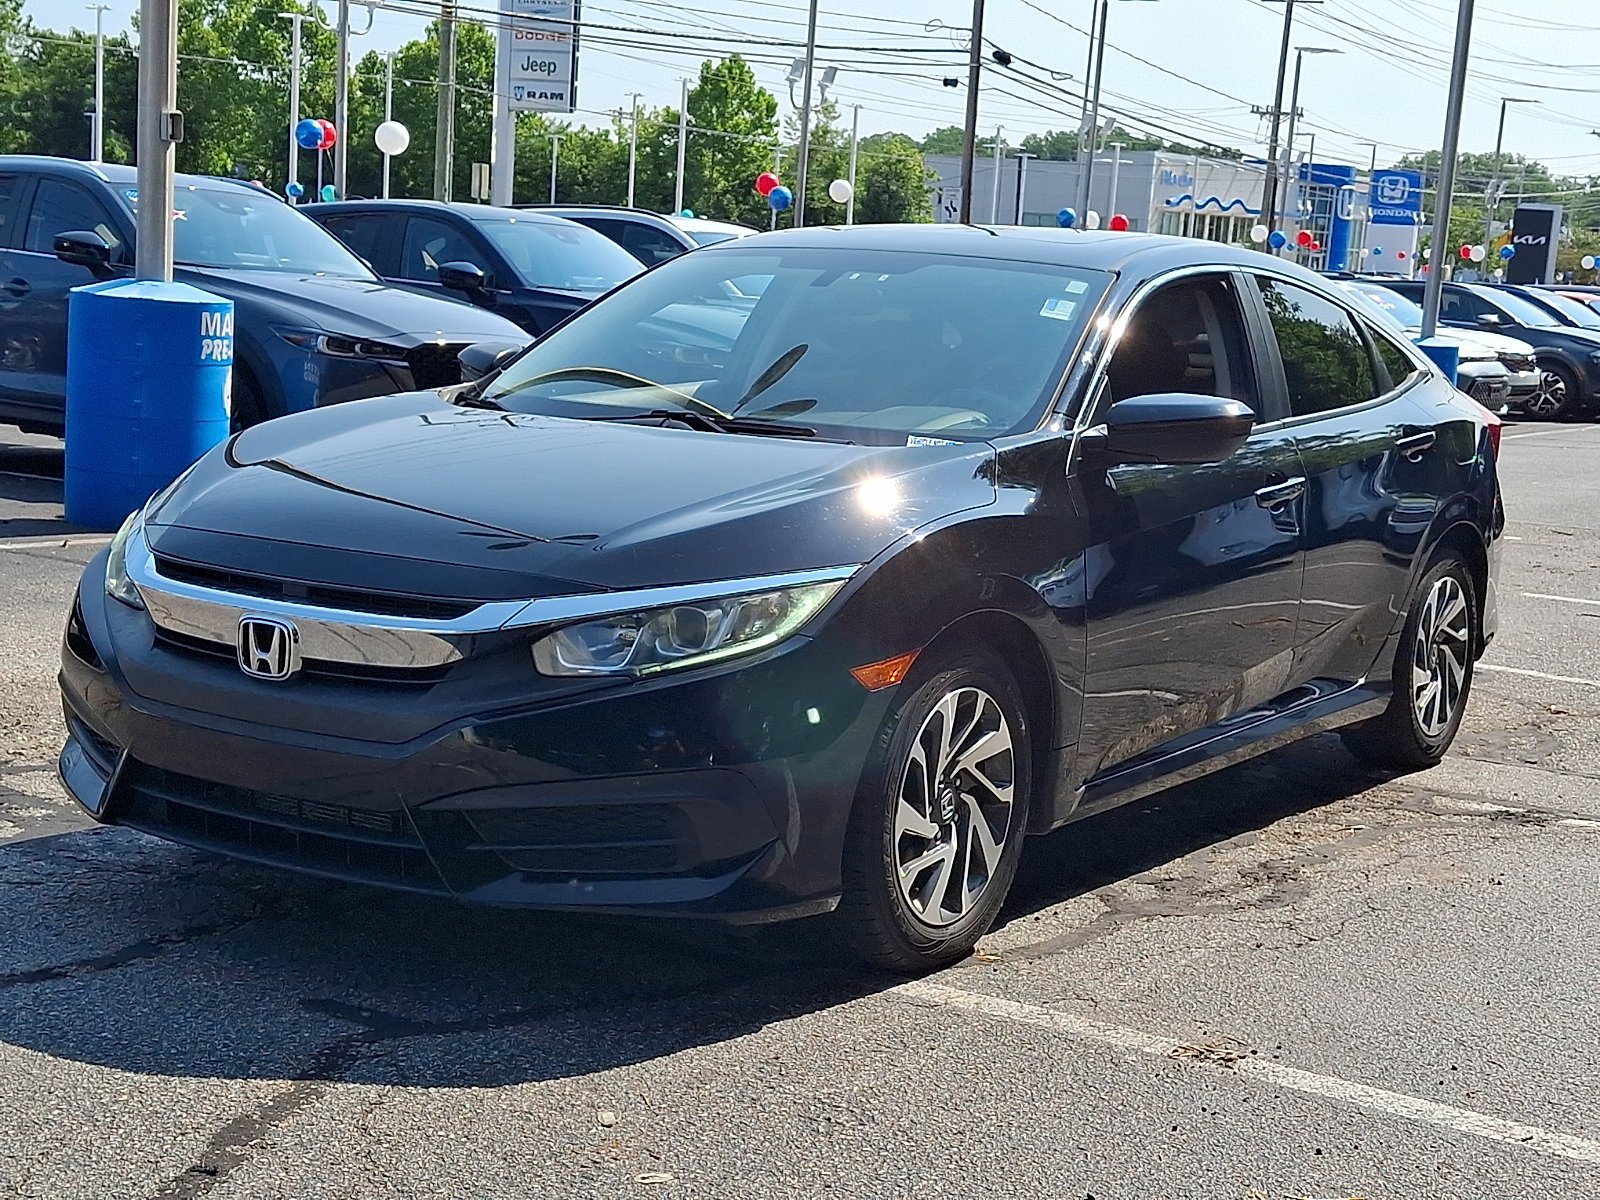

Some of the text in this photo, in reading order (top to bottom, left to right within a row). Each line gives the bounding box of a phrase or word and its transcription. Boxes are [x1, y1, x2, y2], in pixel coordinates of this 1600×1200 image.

[515, 32, 567, 42] DODGE
[521, 55, 557, 76] Jeep
[526, 91, 564, 100] RAM
[1513, 235, 1546, 245] KIA
